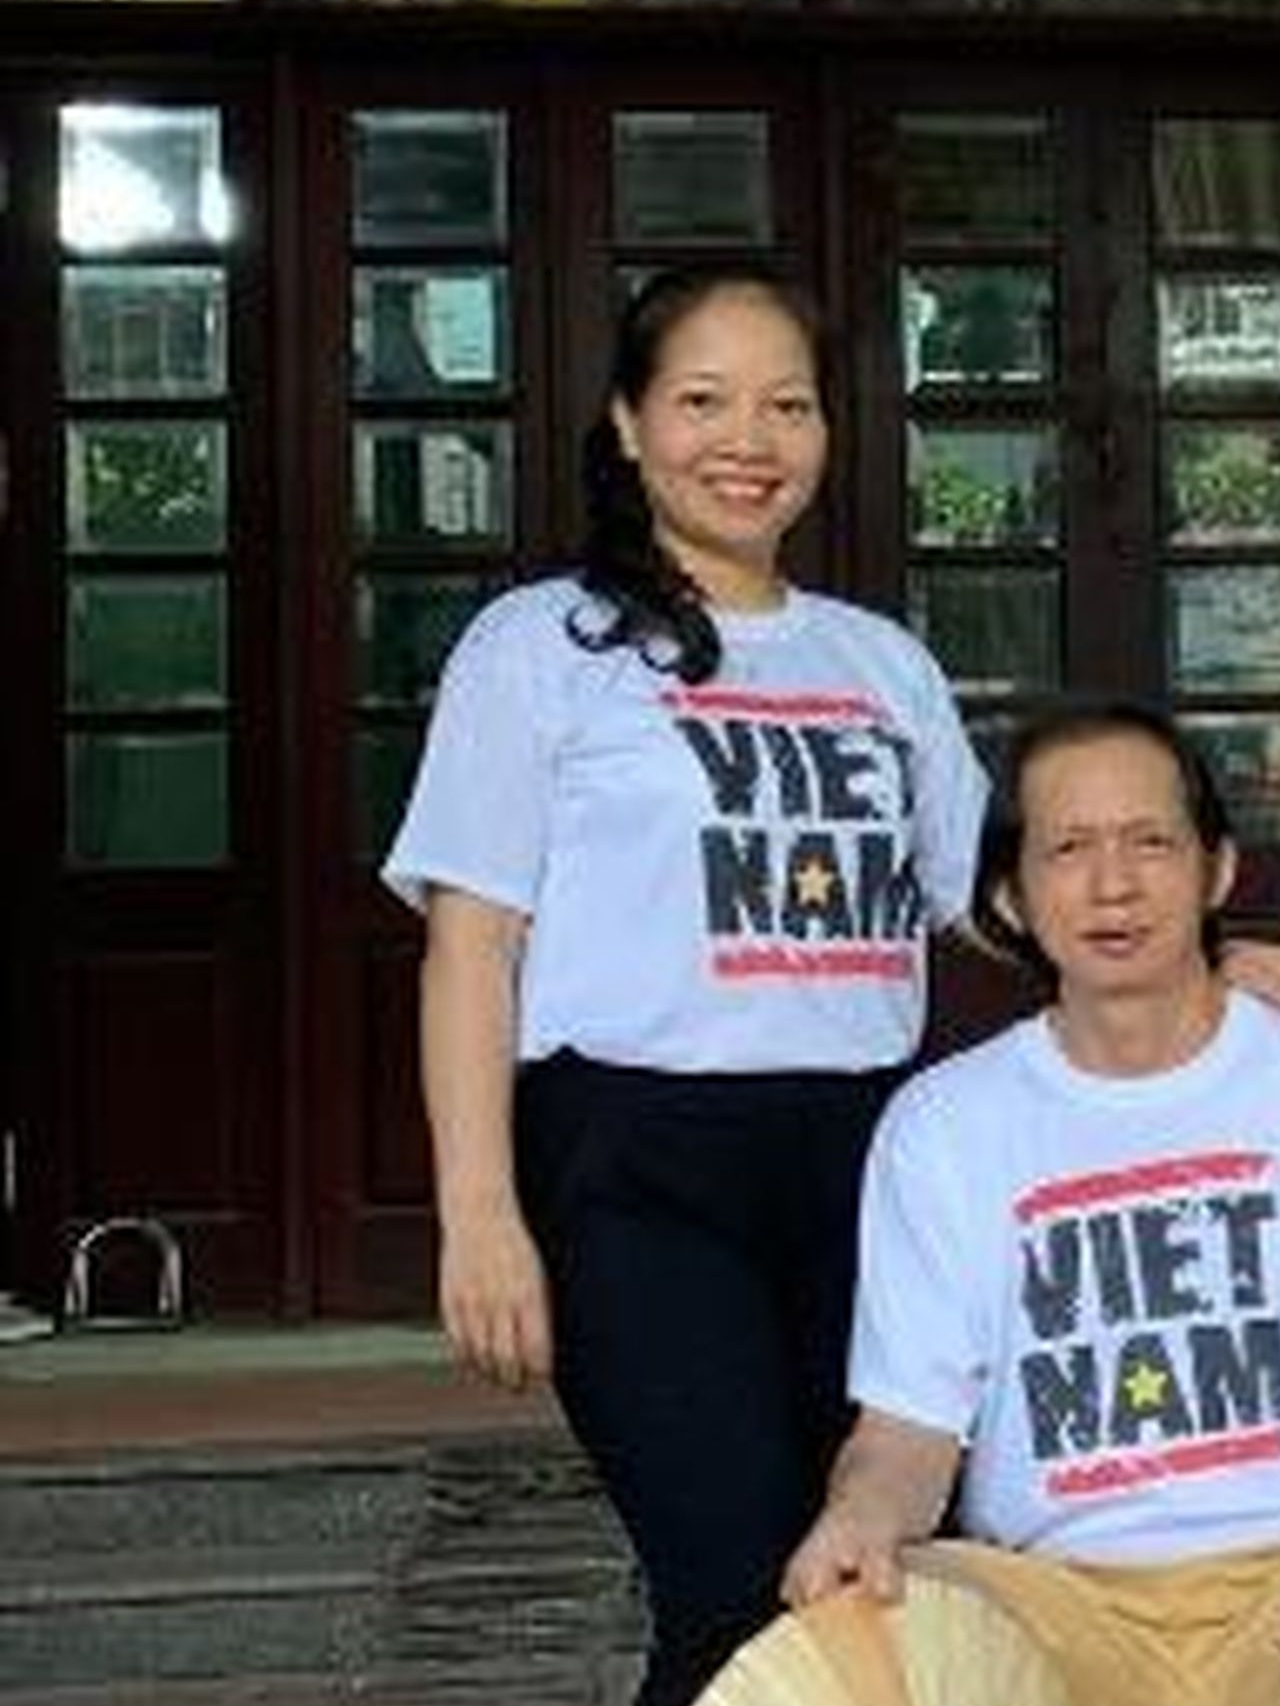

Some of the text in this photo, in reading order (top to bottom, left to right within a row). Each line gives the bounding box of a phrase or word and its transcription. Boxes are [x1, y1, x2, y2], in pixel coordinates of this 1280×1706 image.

[674, 717, 914, 820] VIET
[700, 827, 922, 941] NAM
[1020, 1192, 1277, 1342] VIET
